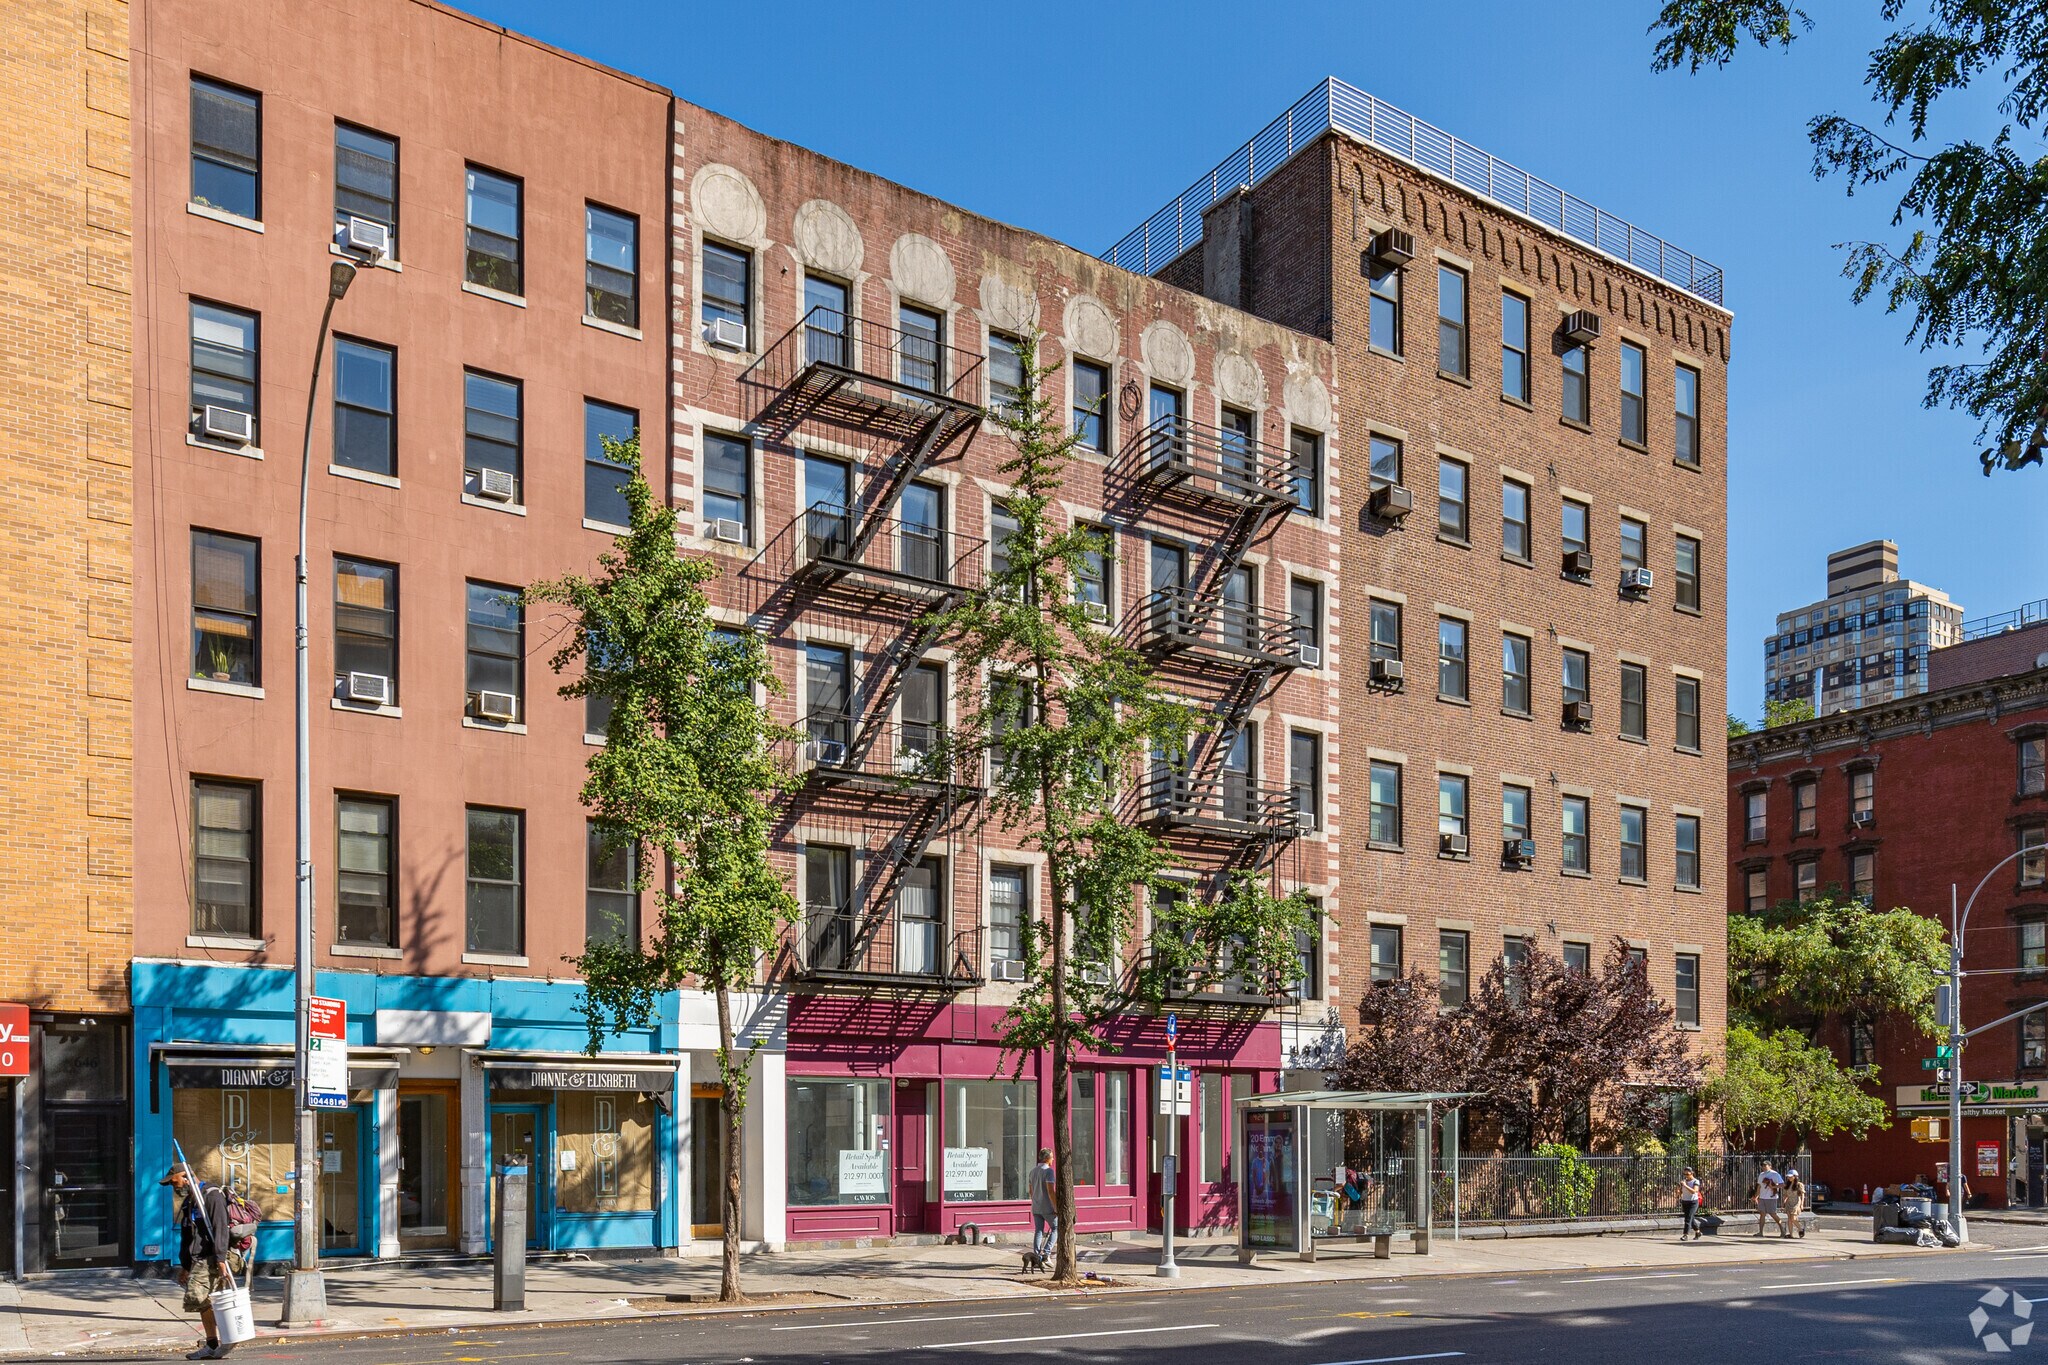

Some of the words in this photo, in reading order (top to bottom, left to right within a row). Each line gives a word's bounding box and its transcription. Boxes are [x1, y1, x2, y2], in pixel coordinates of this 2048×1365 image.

[312, 1039, 319, 1050] 2
[222, 1069, 266, 1085] DIANNE
[531, 1072, 568, 1087] DIANNE
[568, 1072, 586, 1087] &
[587, 1073, 637, 1088] ELISABETH
[1992, 1086, 2038, 1099] Market
[310, 1097, 337, 1105] 104481
[599, 1101, 612, 1131] D
[1960, 1109, 1980, 1117] ealthy
[600, 1161, 612, 1192] E
